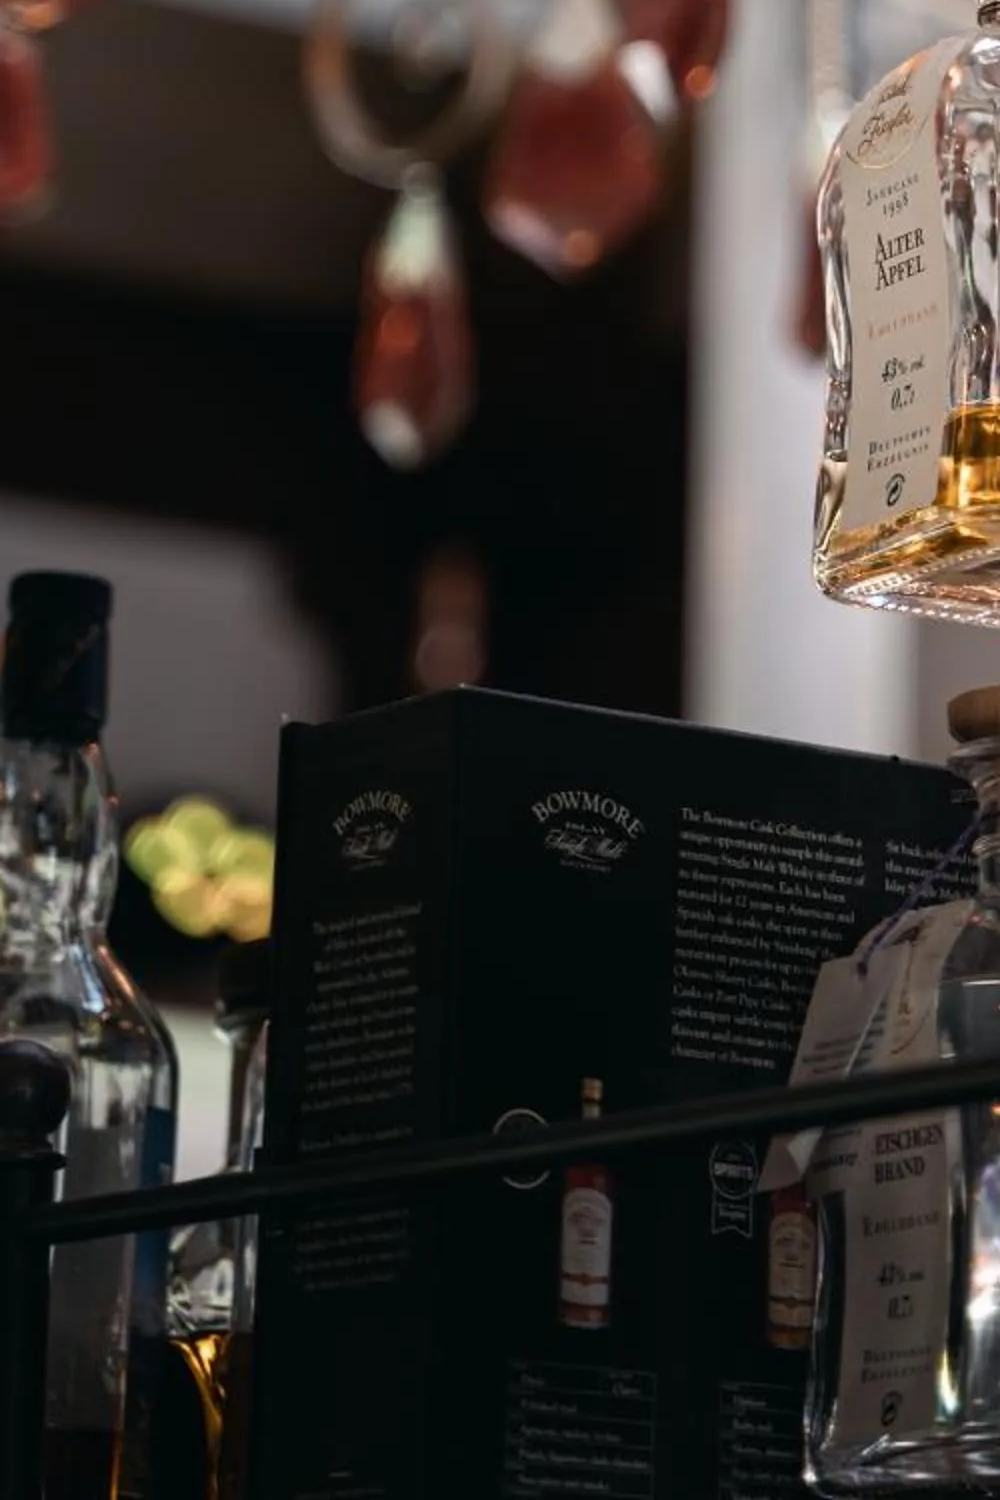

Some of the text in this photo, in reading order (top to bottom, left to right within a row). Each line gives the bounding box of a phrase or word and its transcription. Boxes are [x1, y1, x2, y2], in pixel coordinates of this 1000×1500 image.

[875, 228, 925, 265] ALTER
[331, 790, 413, 836] BOWMORE
[531, 790, 645, 839] BOWMORE
[874, 1156, 925, 1184] BRAND
